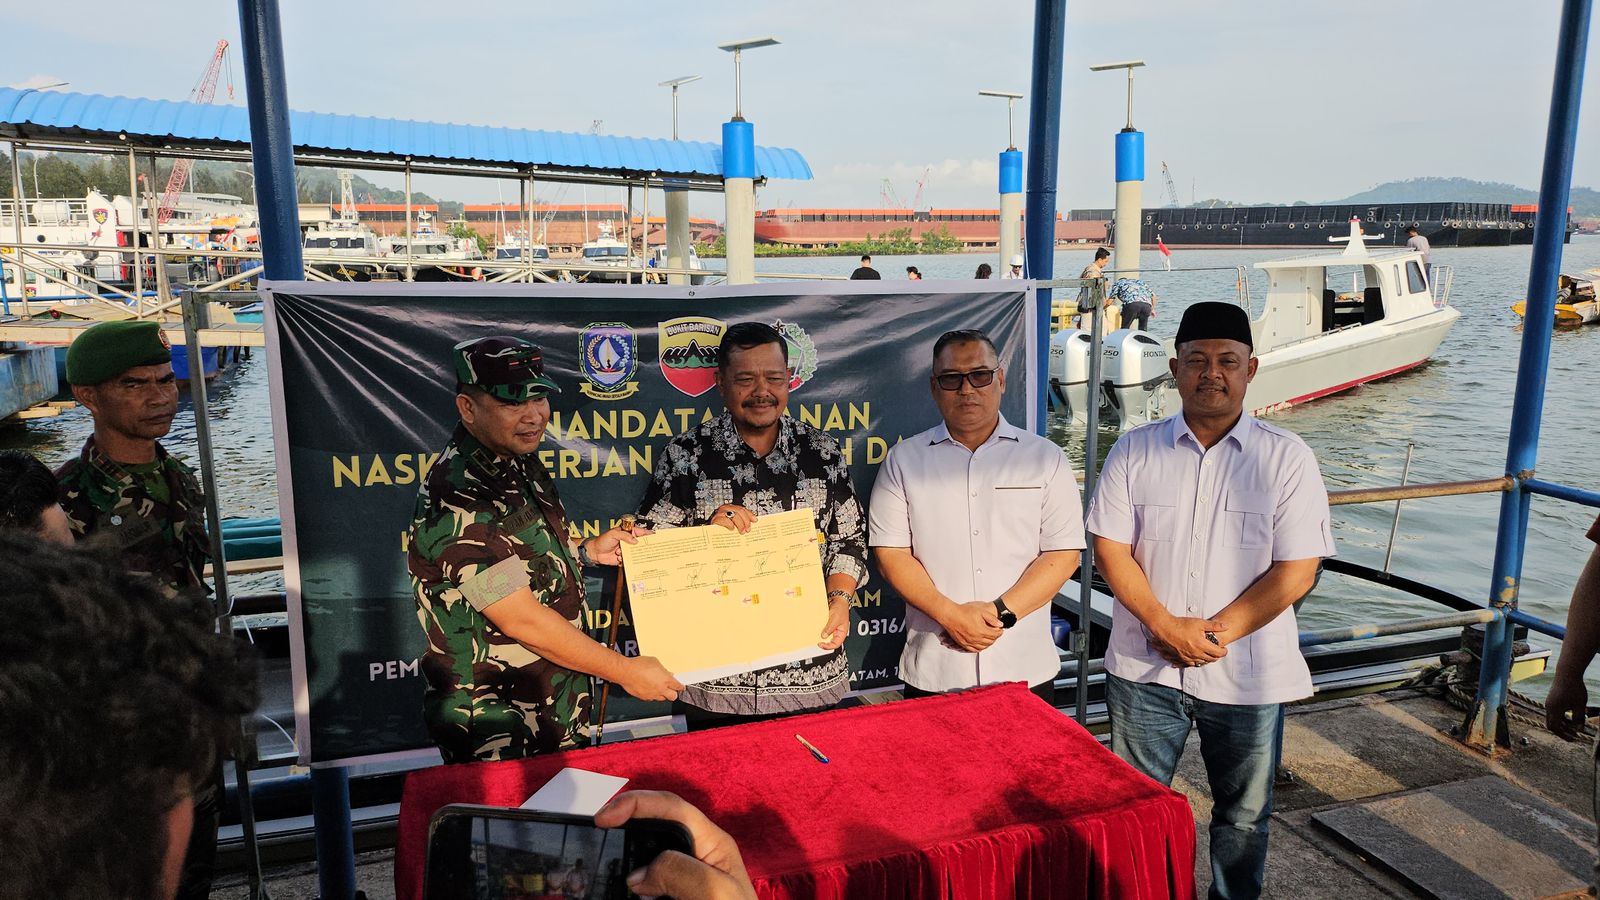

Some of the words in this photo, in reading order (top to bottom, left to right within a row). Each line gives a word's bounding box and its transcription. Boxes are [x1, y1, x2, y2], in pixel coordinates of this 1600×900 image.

[666, 323, 688, 336] BUKIT
[688, 322, 720, 335] BARISAN
[1103, 349, 1119, 357] 250
[1143, 350, 1167, 358] HONDA
[332, 453, 439, 488] NASK
[848, 668, 889, 682] ATAM,
